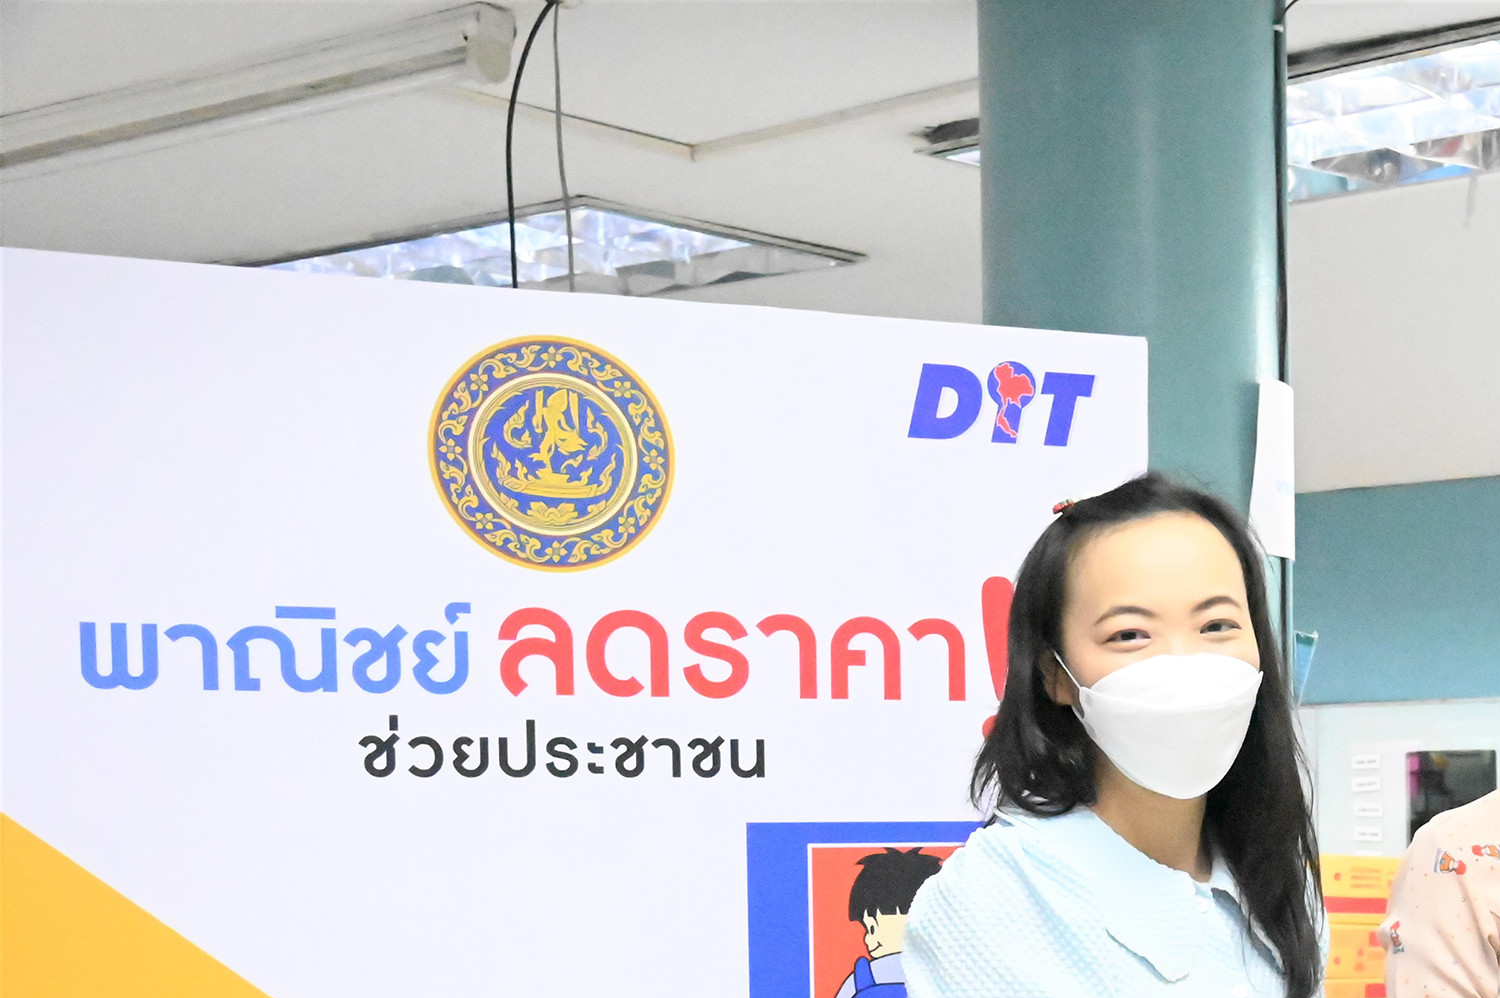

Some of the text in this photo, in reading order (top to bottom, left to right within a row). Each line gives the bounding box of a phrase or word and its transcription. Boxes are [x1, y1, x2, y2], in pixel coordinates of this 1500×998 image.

[79, 602, 472, 695] พาณิชย์
[358, 714, 766, 779] ช่วยประชาชน
